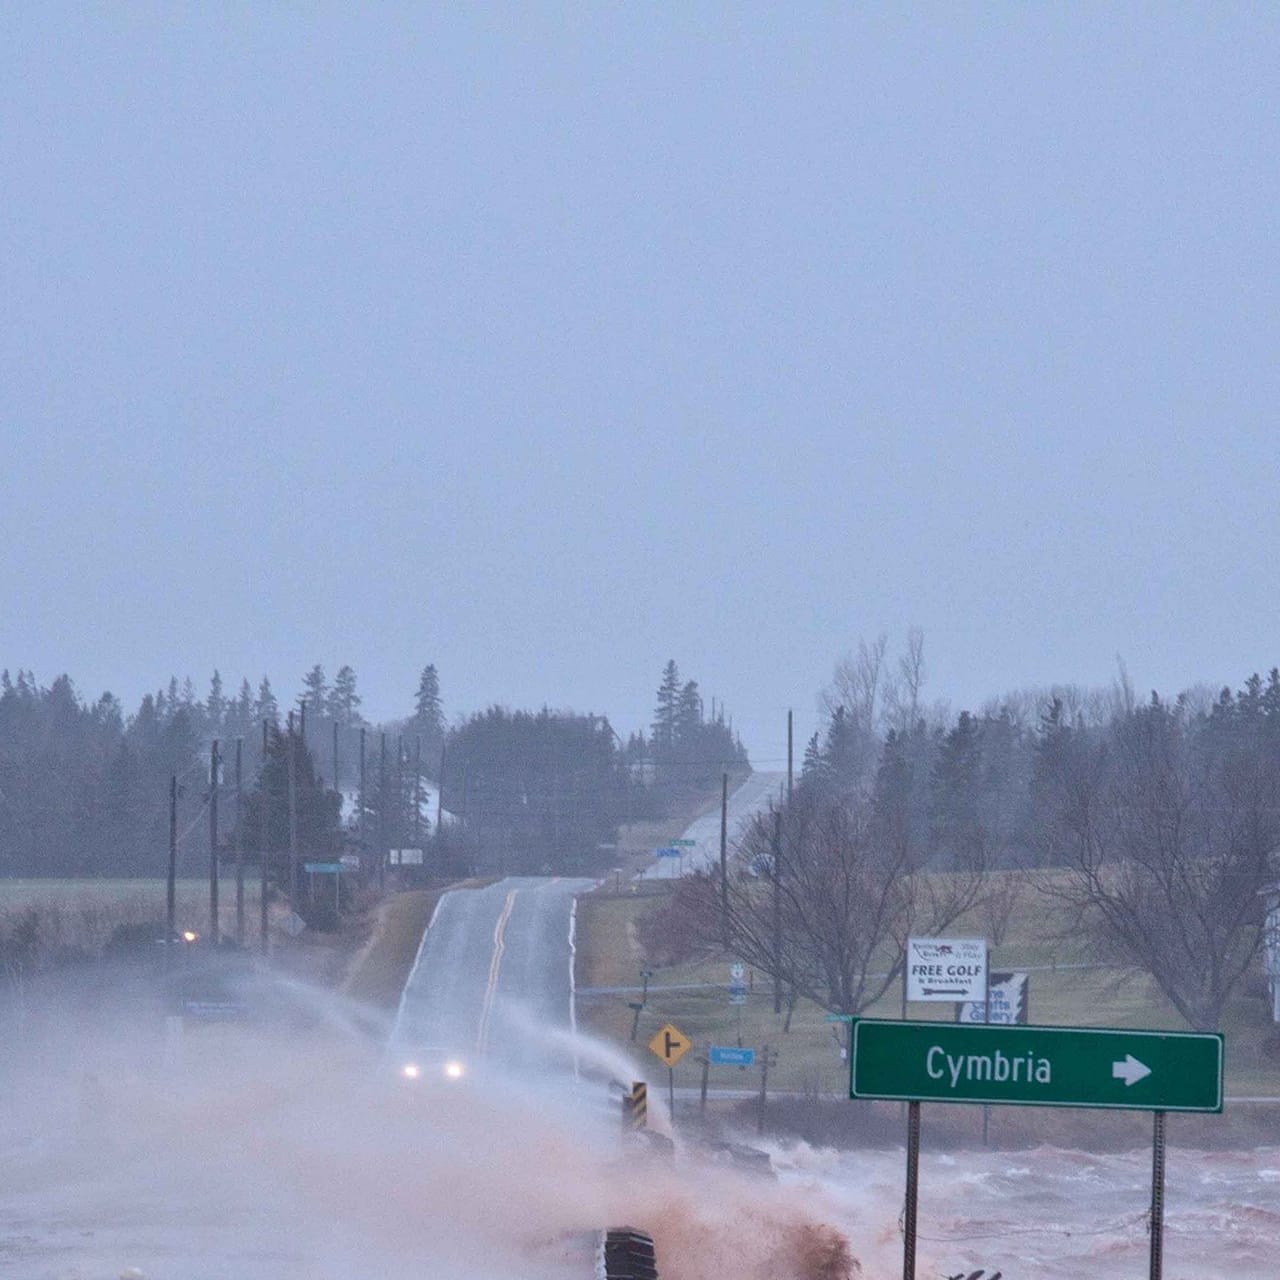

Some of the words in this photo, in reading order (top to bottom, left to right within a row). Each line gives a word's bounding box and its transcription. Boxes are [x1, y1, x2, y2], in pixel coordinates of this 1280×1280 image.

[912, 965, 943, 976] FREE
[947, 965, 982, 976] GOLF
[926, 1045, 1051, 1088] Cymbria
